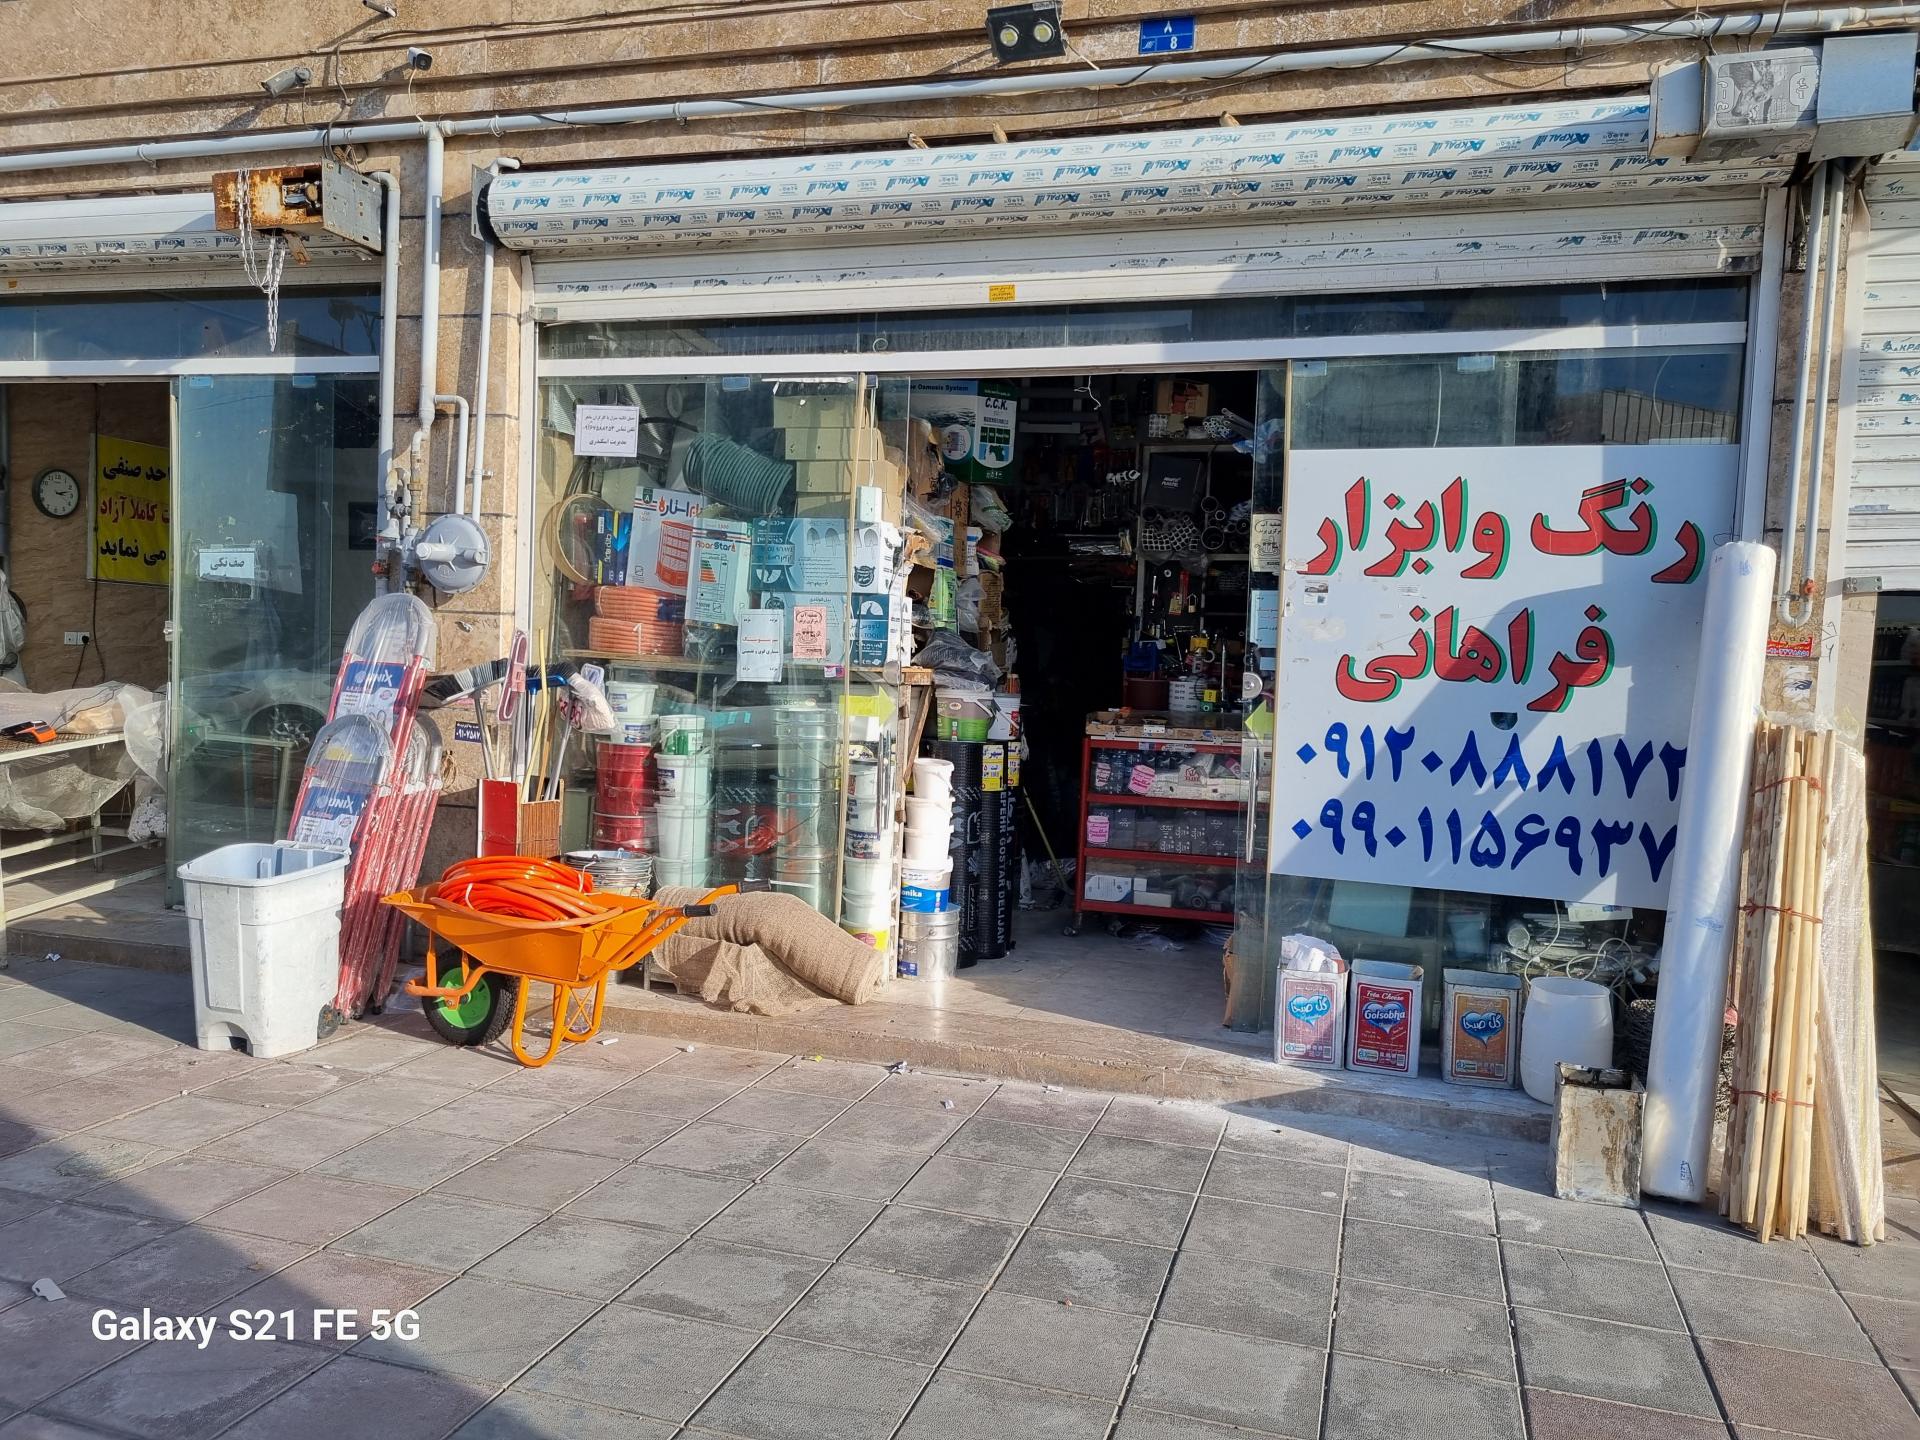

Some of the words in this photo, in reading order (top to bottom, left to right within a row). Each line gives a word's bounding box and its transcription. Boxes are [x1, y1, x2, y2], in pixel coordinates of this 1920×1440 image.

[1170, 36, 1178, 49] 8
[102, 457, 141, 480] صنفی
[100, 495, 127, 523] آزاد
[1531, 477, 1705, 583] رنگ
[100, 537, 139, 561] نماید
[1336, 604, 1615, 713] فراهانی
[998, 837, 1006, 888] GOSTAR
[997, 892, 1006, 944] DELIJAN
[1364, 1009, 1406, 1021] Golsobha
